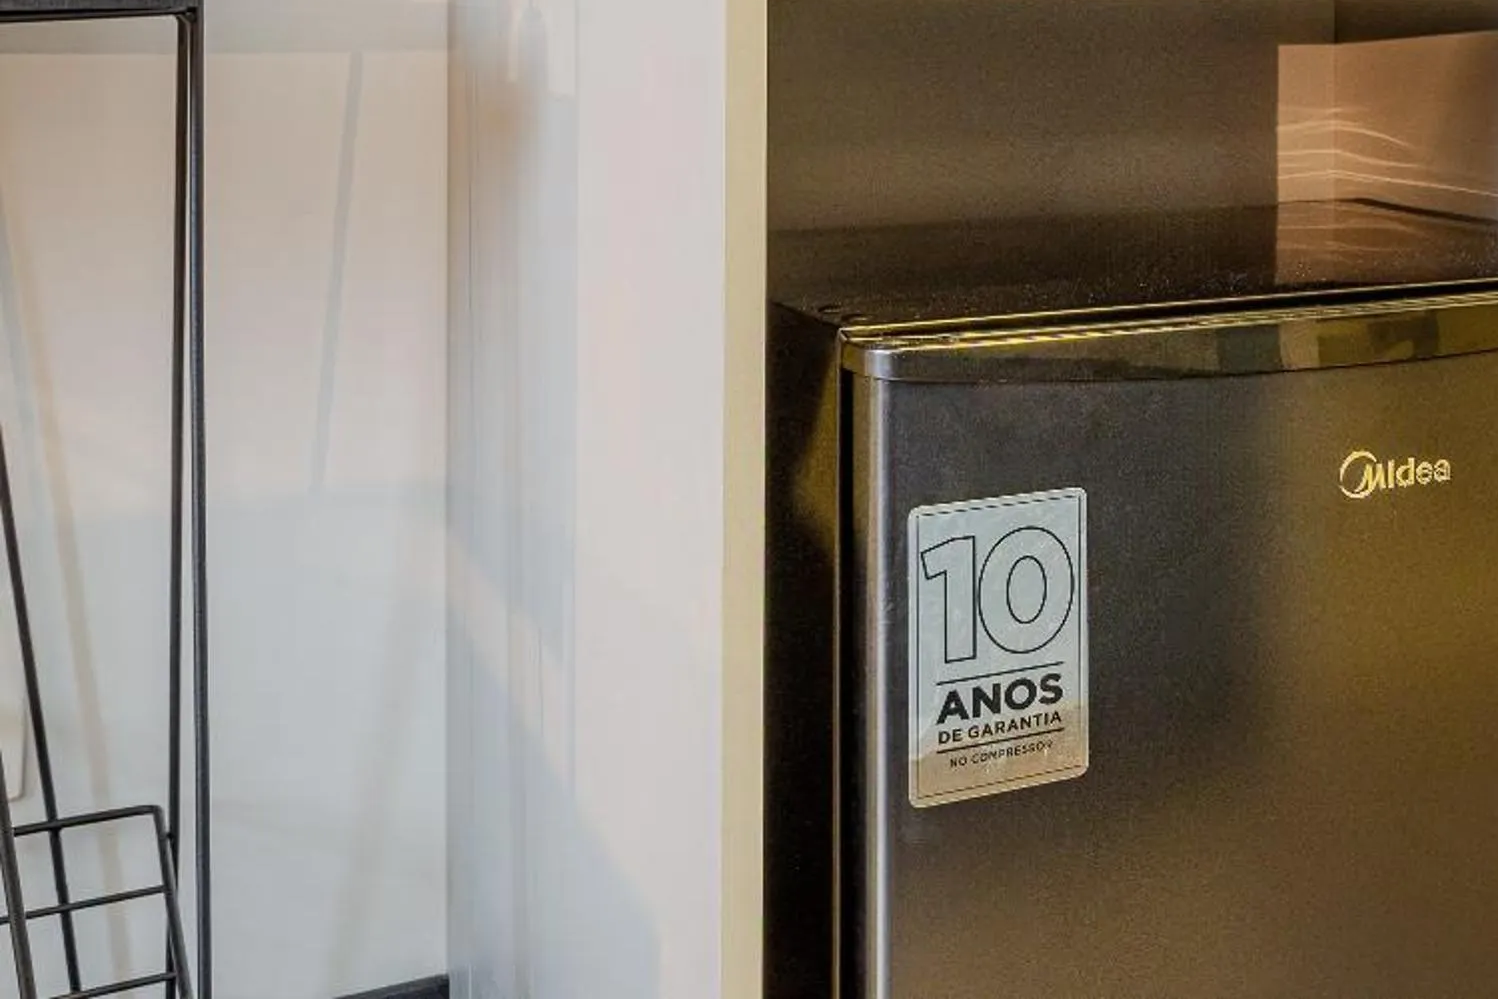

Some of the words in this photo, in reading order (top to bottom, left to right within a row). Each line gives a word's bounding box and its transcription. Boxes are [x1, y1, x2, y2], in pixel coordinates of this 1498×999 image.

[1340, 451, 1451, 498] Midea
[920, 525, 1075, 665] 10
[936, 672, 1065, 725] ANOS
[938, 728, 963, 745] DE
[967, 710, 1063, 739] GARANTIA
[950, 756, 968, 768] NO
